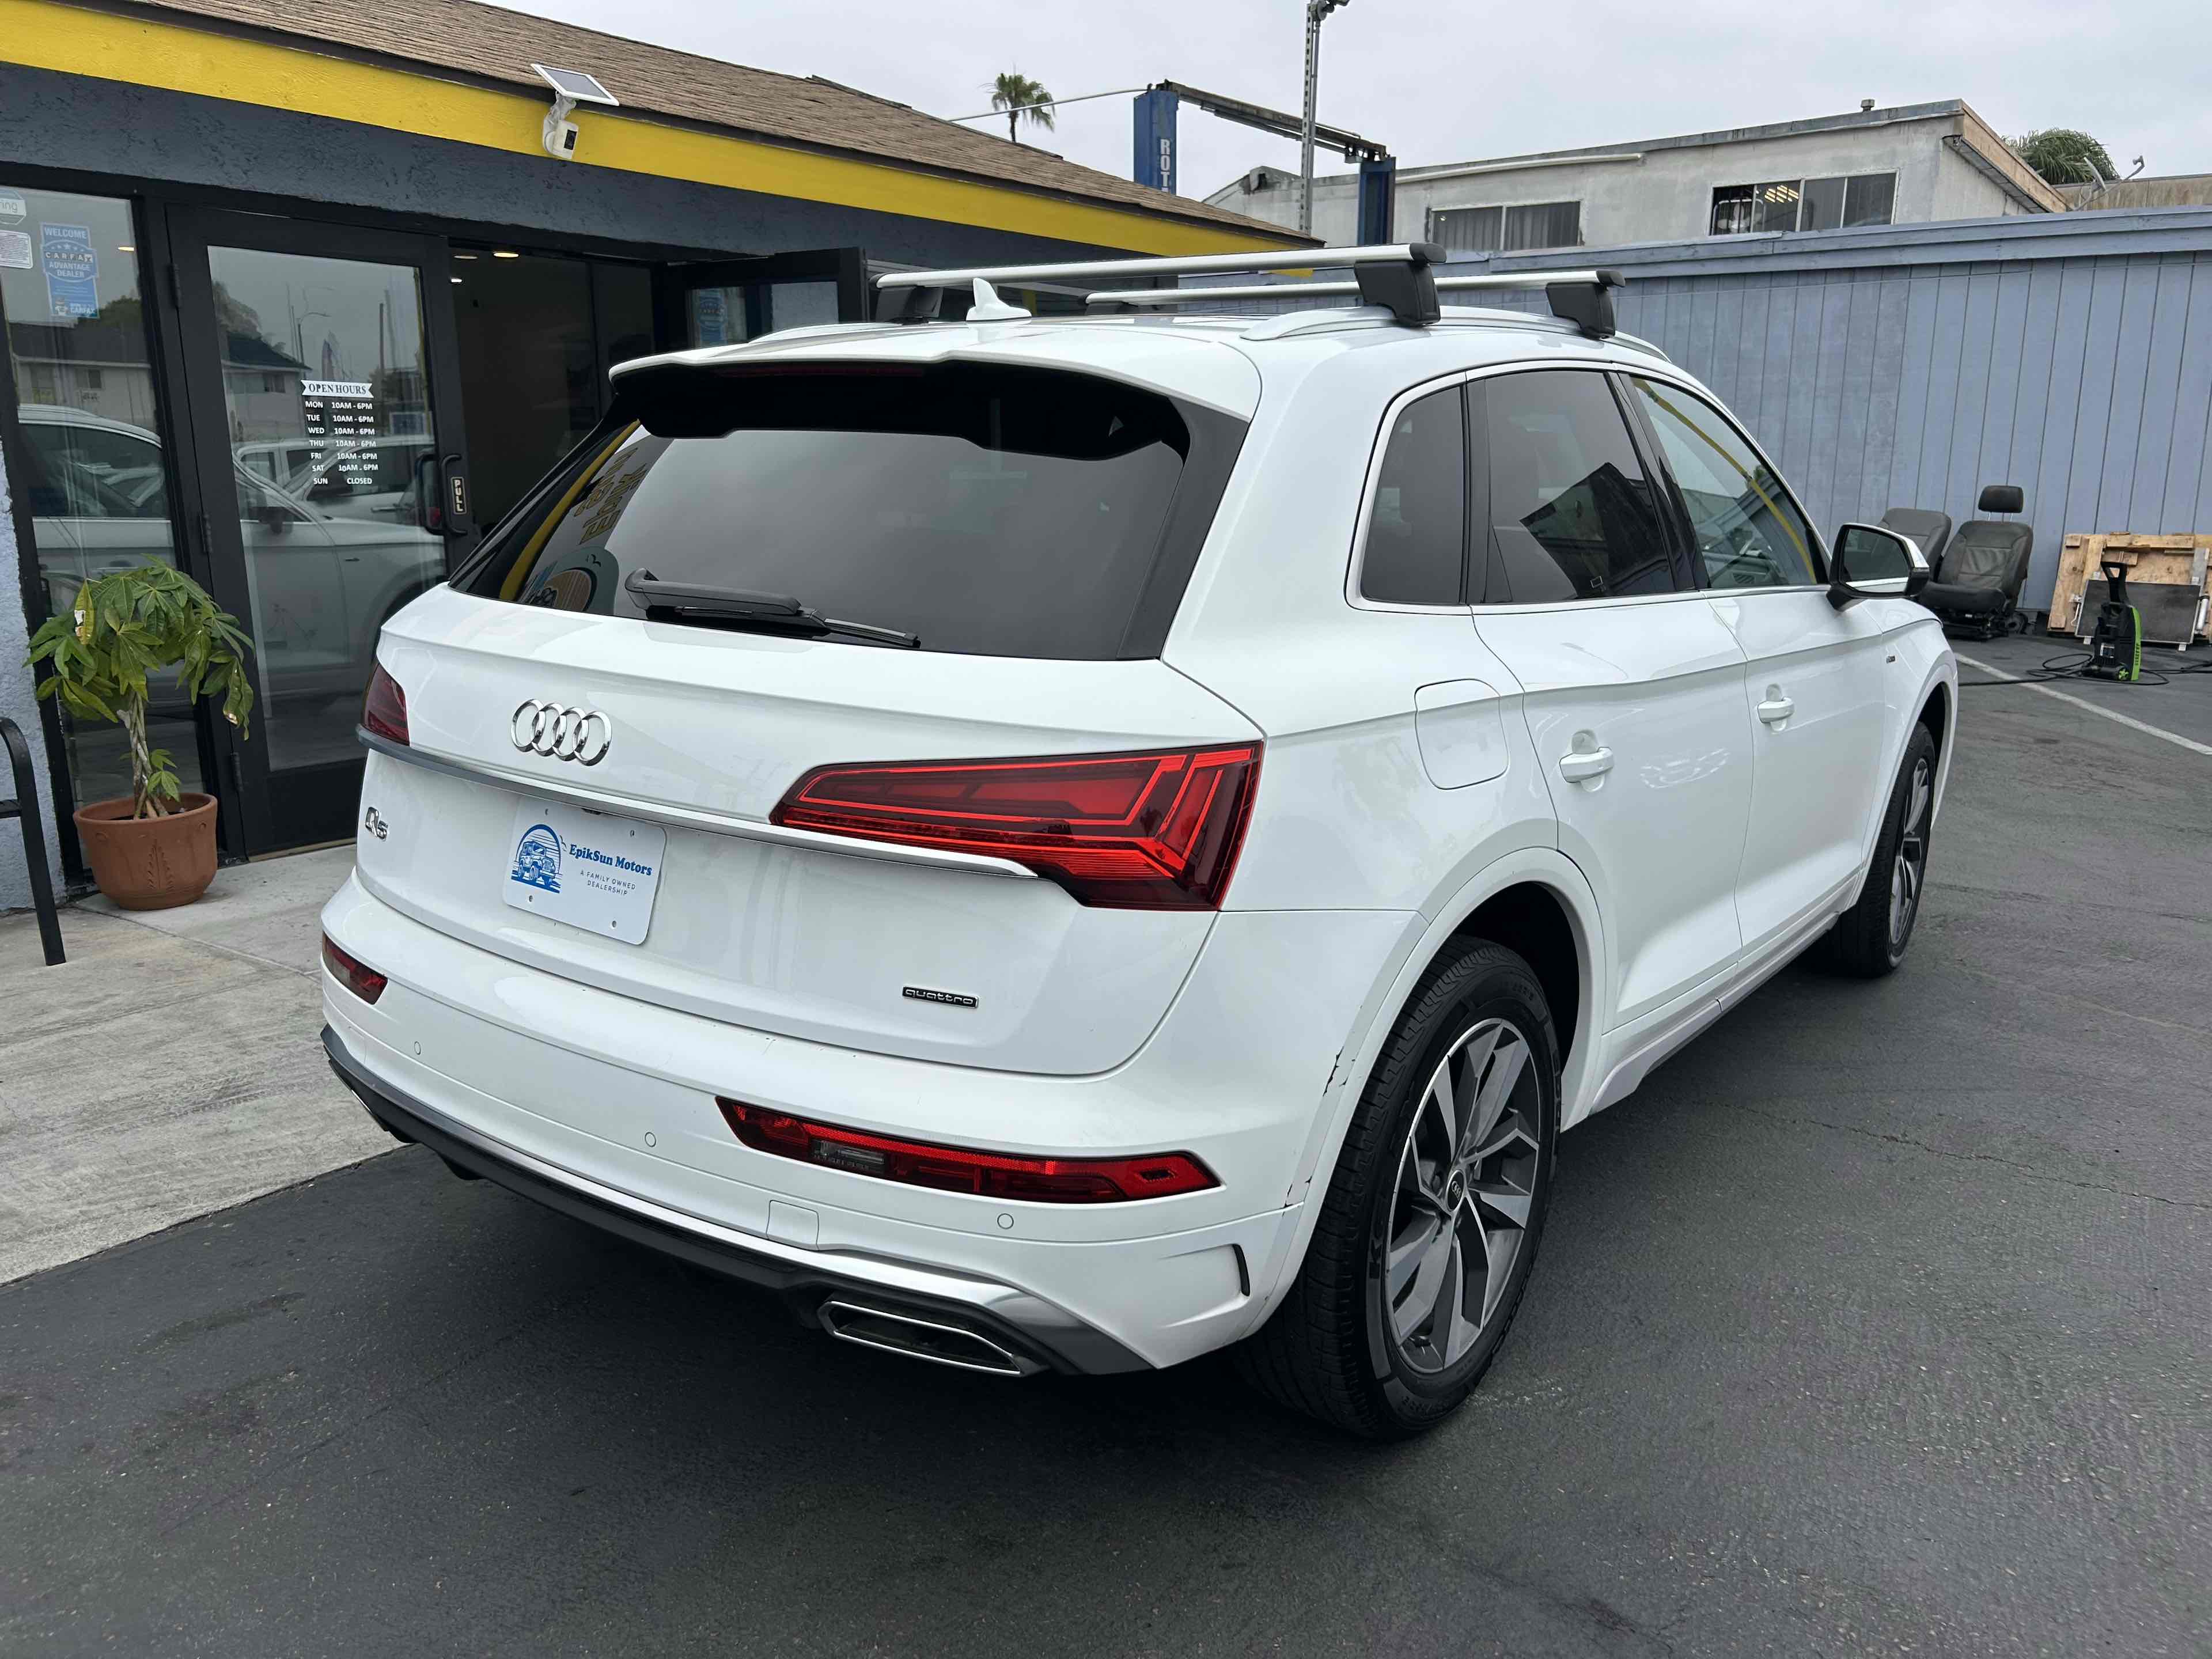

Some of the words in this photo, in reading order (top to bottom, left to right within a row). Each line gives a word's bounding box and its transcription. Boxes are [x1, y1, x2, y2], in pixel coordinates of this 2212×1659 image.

[1160, 138, 1171, 192] ROT
[45, 227, 87, 239] WELCOME
[46, 252, 93, 263] CARFAX
[57, 270, 85, 278] DEALER
[308, 383, 334, 393] OPEN
[335, 384, 366, 395] HOURS
[453, 479, 464, 512] PULL
[365, 806, 388, 839] Q5
[569, 844, 613, 865] EpikSun
[615, 856, 652, 876] Motors
[586, 872, 609, 882] FAMILY
[612, 878, 636, 890] OWNED
[587, 880, 628, 895] DEALERSHIP
[905, 988, 974, 1005] quattro
